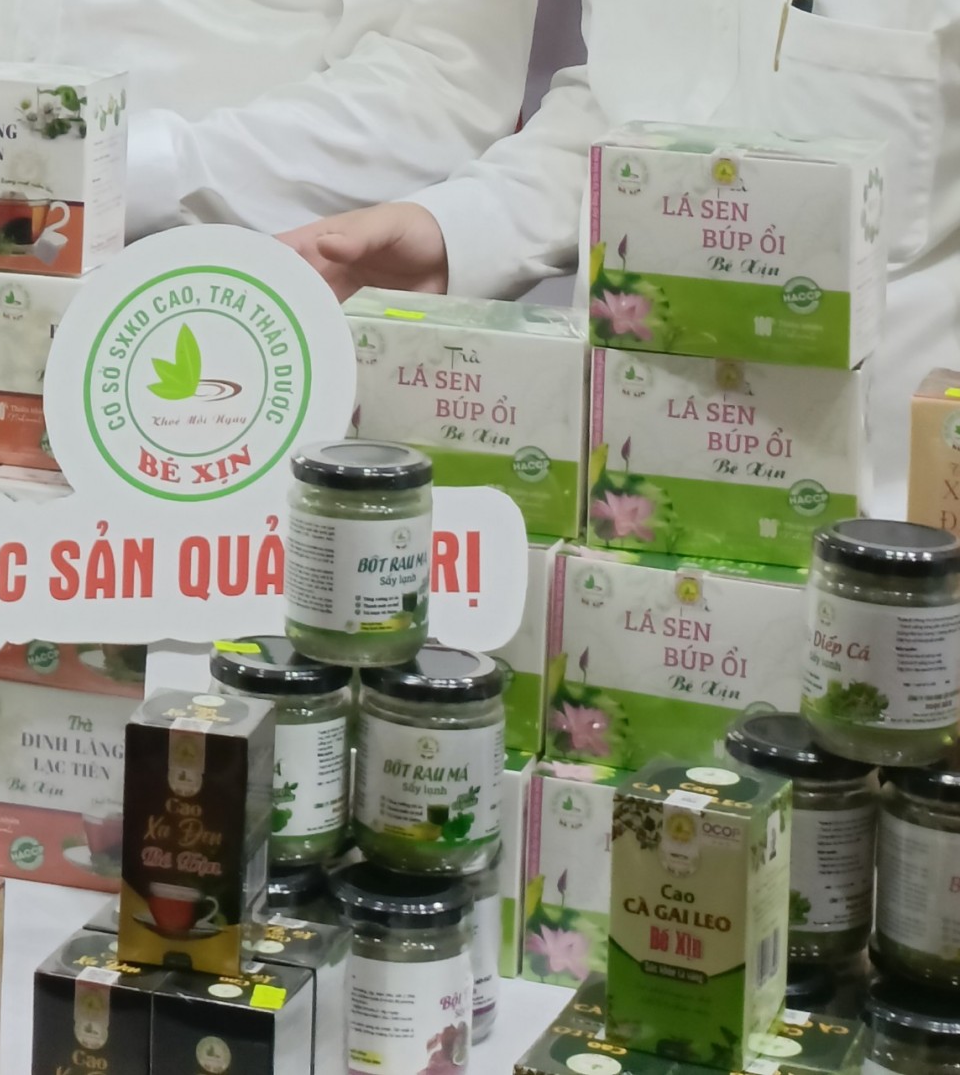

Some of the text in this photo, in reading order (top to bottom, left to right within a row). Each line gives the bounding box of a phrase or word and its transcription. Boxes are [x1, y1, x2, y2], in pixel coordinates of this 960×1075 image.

[662, 191, 749, 223] LÁ SEN
[702, 223, 786, 256] BÚP ỔI
[151, 284, 201, 315] CAO,
[209, 284, 248, 314] TRÀ
[782, 288, 825, 304] HACCP
[108, 308, 151, 361] SXKD
[247, 303, 290, 359] THẢO
[443, 345, 482, 370] Trà
[397, 363, 482, 393] LÁ SEN
[264, 364, 295, 426] DƯỢC
[435, 394, 517, 426] BÚP ỔI
[666, 394, 756, 427] LÁ SEN
[707, 426, 793, 458] BÚP ỔI
[137, 443, 252, 485] BÉ XỊN
[49, 519, 155, 601] SẢN
[624, 608, 712, 643] LÁ SEN
[663, 644, 748, 679] BÚP ỔI
[813, 629, 871, 663] Diếp Cá
[660, 883, 696, 905] Cao
[623, 894, 732, 933] CÀ GAI LEO
[71, 1048, 108, 1070] Cao
